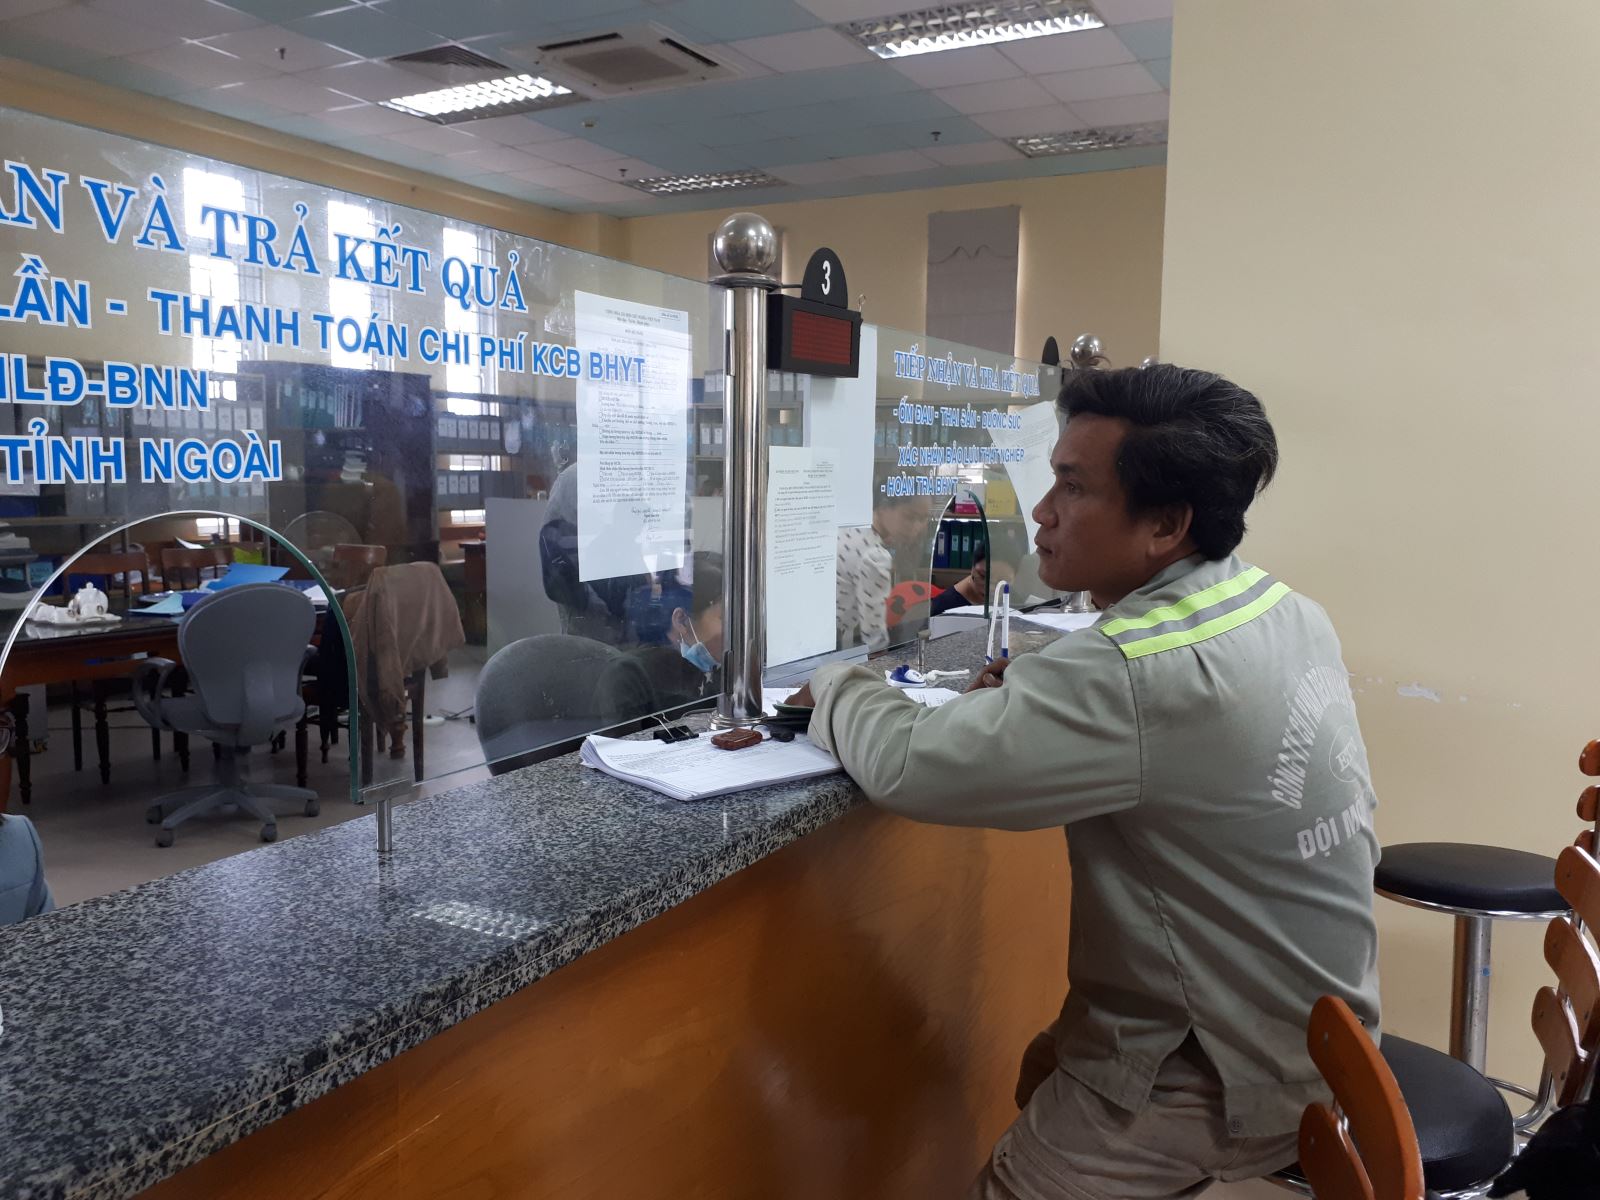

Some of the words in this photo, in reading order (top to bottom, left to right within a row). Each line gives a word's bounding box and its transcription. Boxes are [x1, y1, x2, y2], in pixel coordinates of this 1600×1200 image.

[0, 160, 68, 233] N
[80, 173, 186, 252] VÀ
[201, 202, 321, 275] TRẢ
[333, 224, 430, 294] KẾT
[441, 250, 528, 312] QUẢ
[821, 260, 831, 295] 3
[148, 288, 300, 348] THANH
[313, 313, 408, 361] TOÁN
[418, 328, 470, 366] CHI
[479, 331, 527, 372] PHÍ
[532, 342, 581, 379] KCB
[588, 350, 646, 384] BHYT
[894, 343, 926, 380] TIẾP
[927, 352, 960, 391] NHẬN
[960, 357, 978, 388] VÀ
[915, 404, 934, 425] ĐAU
[940, 406, 959, 427] THAI
[961, 402, 977, 428] SẢN
[0, 417, 126, 485] TỈNH
[140, 429, 283, 484] NGOÀI
[887, 471, 915, 496] HOÀN
[916, 468, 935, 496] TRẢ
[936, 476, 958, 496] BHYT
[1282, 728, 1310, 764] TY
[1267, 753, 1306, 809] CÔNG
[1297, 816, 1340, 860] ĐỘI
